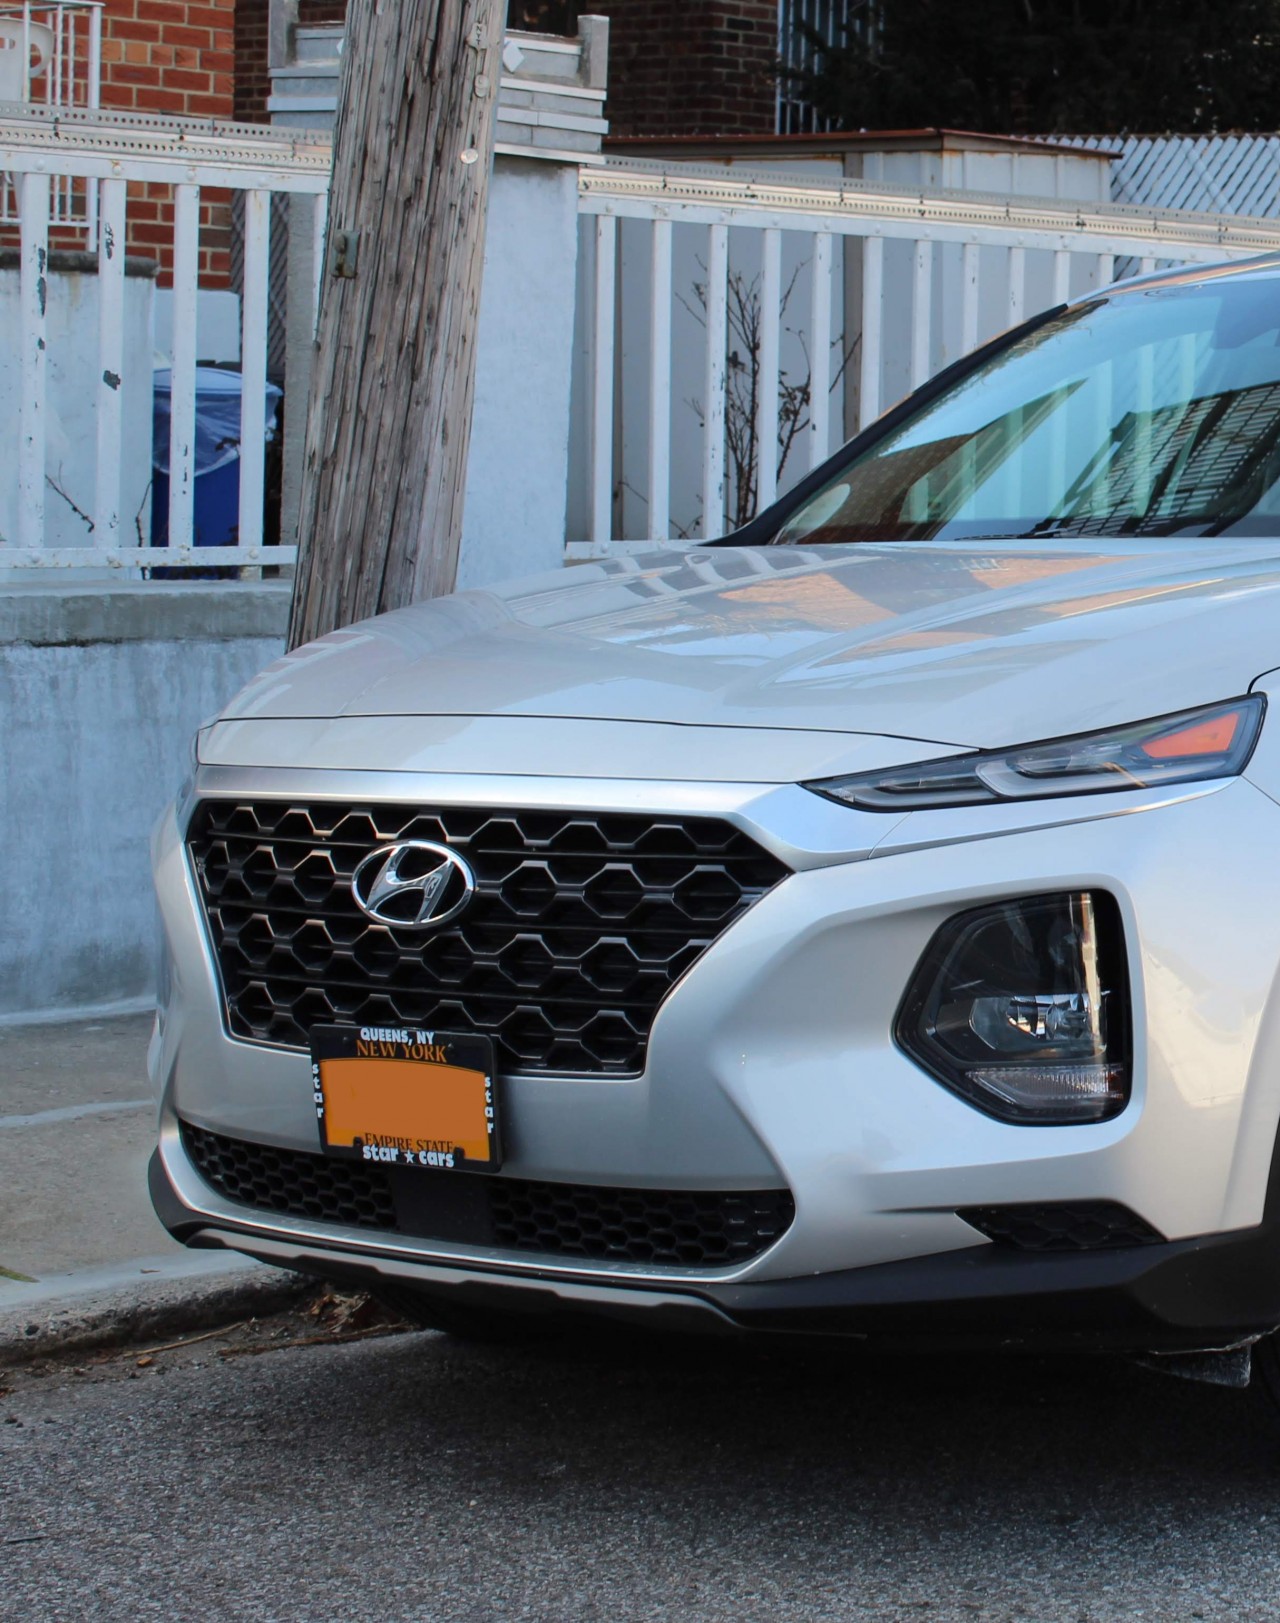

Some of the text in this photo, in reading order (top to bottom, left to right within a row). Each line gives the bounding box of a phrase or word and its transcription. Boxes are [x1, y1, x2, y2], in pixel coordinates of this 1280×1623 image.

[360, 1027, 435, 1046] QUEENS, NY
[356, 1039, 448, 1063] NEW YORK
[363, 1132, 454, 1153] EMPIRE STATE
[362, 1145, 455, 1168] star cars
